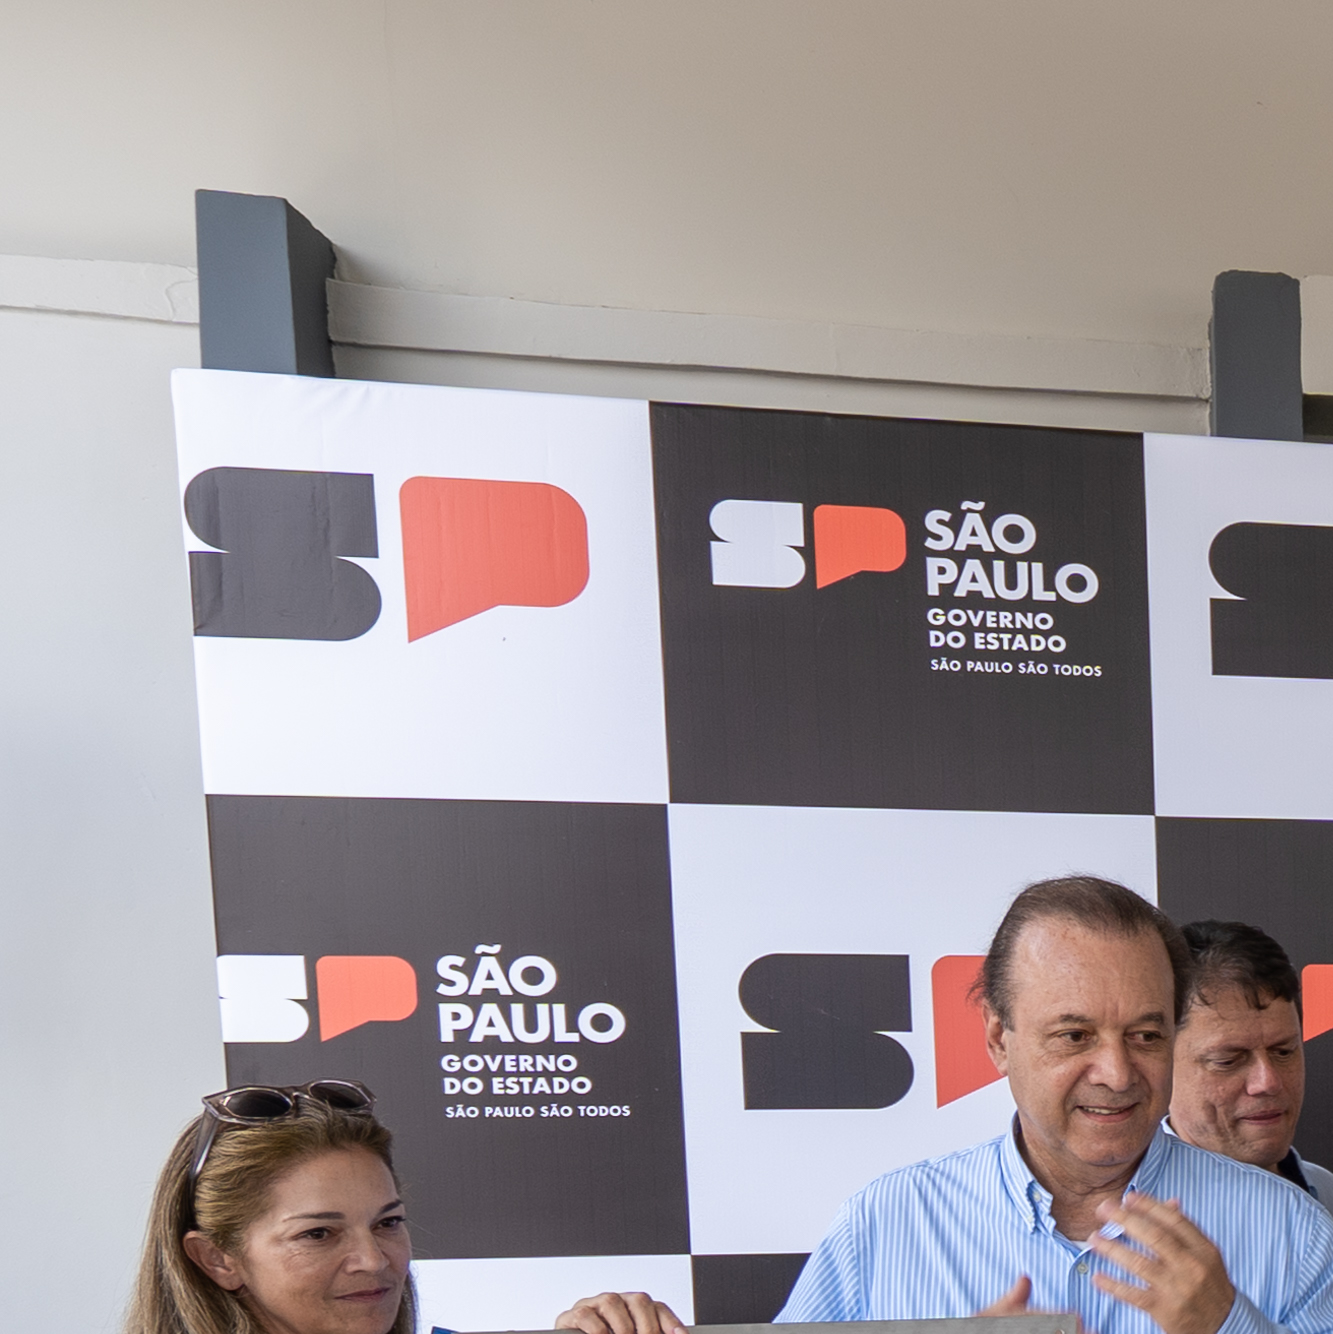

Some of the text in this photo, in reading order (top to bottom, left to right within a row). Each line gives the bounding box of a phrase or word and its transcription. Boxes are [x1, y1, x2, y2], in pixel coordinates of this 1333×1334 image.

[924, 500, 1036, 554] SÃO
[926, 556, 1099, 603] PAULO
[927, 607, 1053, 630] GOVERNO
[929, 630, 1066, 652] DO ESTADO
[930, 657, 1102, 677] SÃO PAULO SÃO TODOS
[436, 944, 557, 996] SÃO
[438, 1002, 625, 1043] PAULO
[441, 1054, 577, 1072] GOVERNO
[443, 1076, 592, 1095] DO ESTADO
[445, 1103, 630, 1118] SÃO PAULO SÃO TODOS
